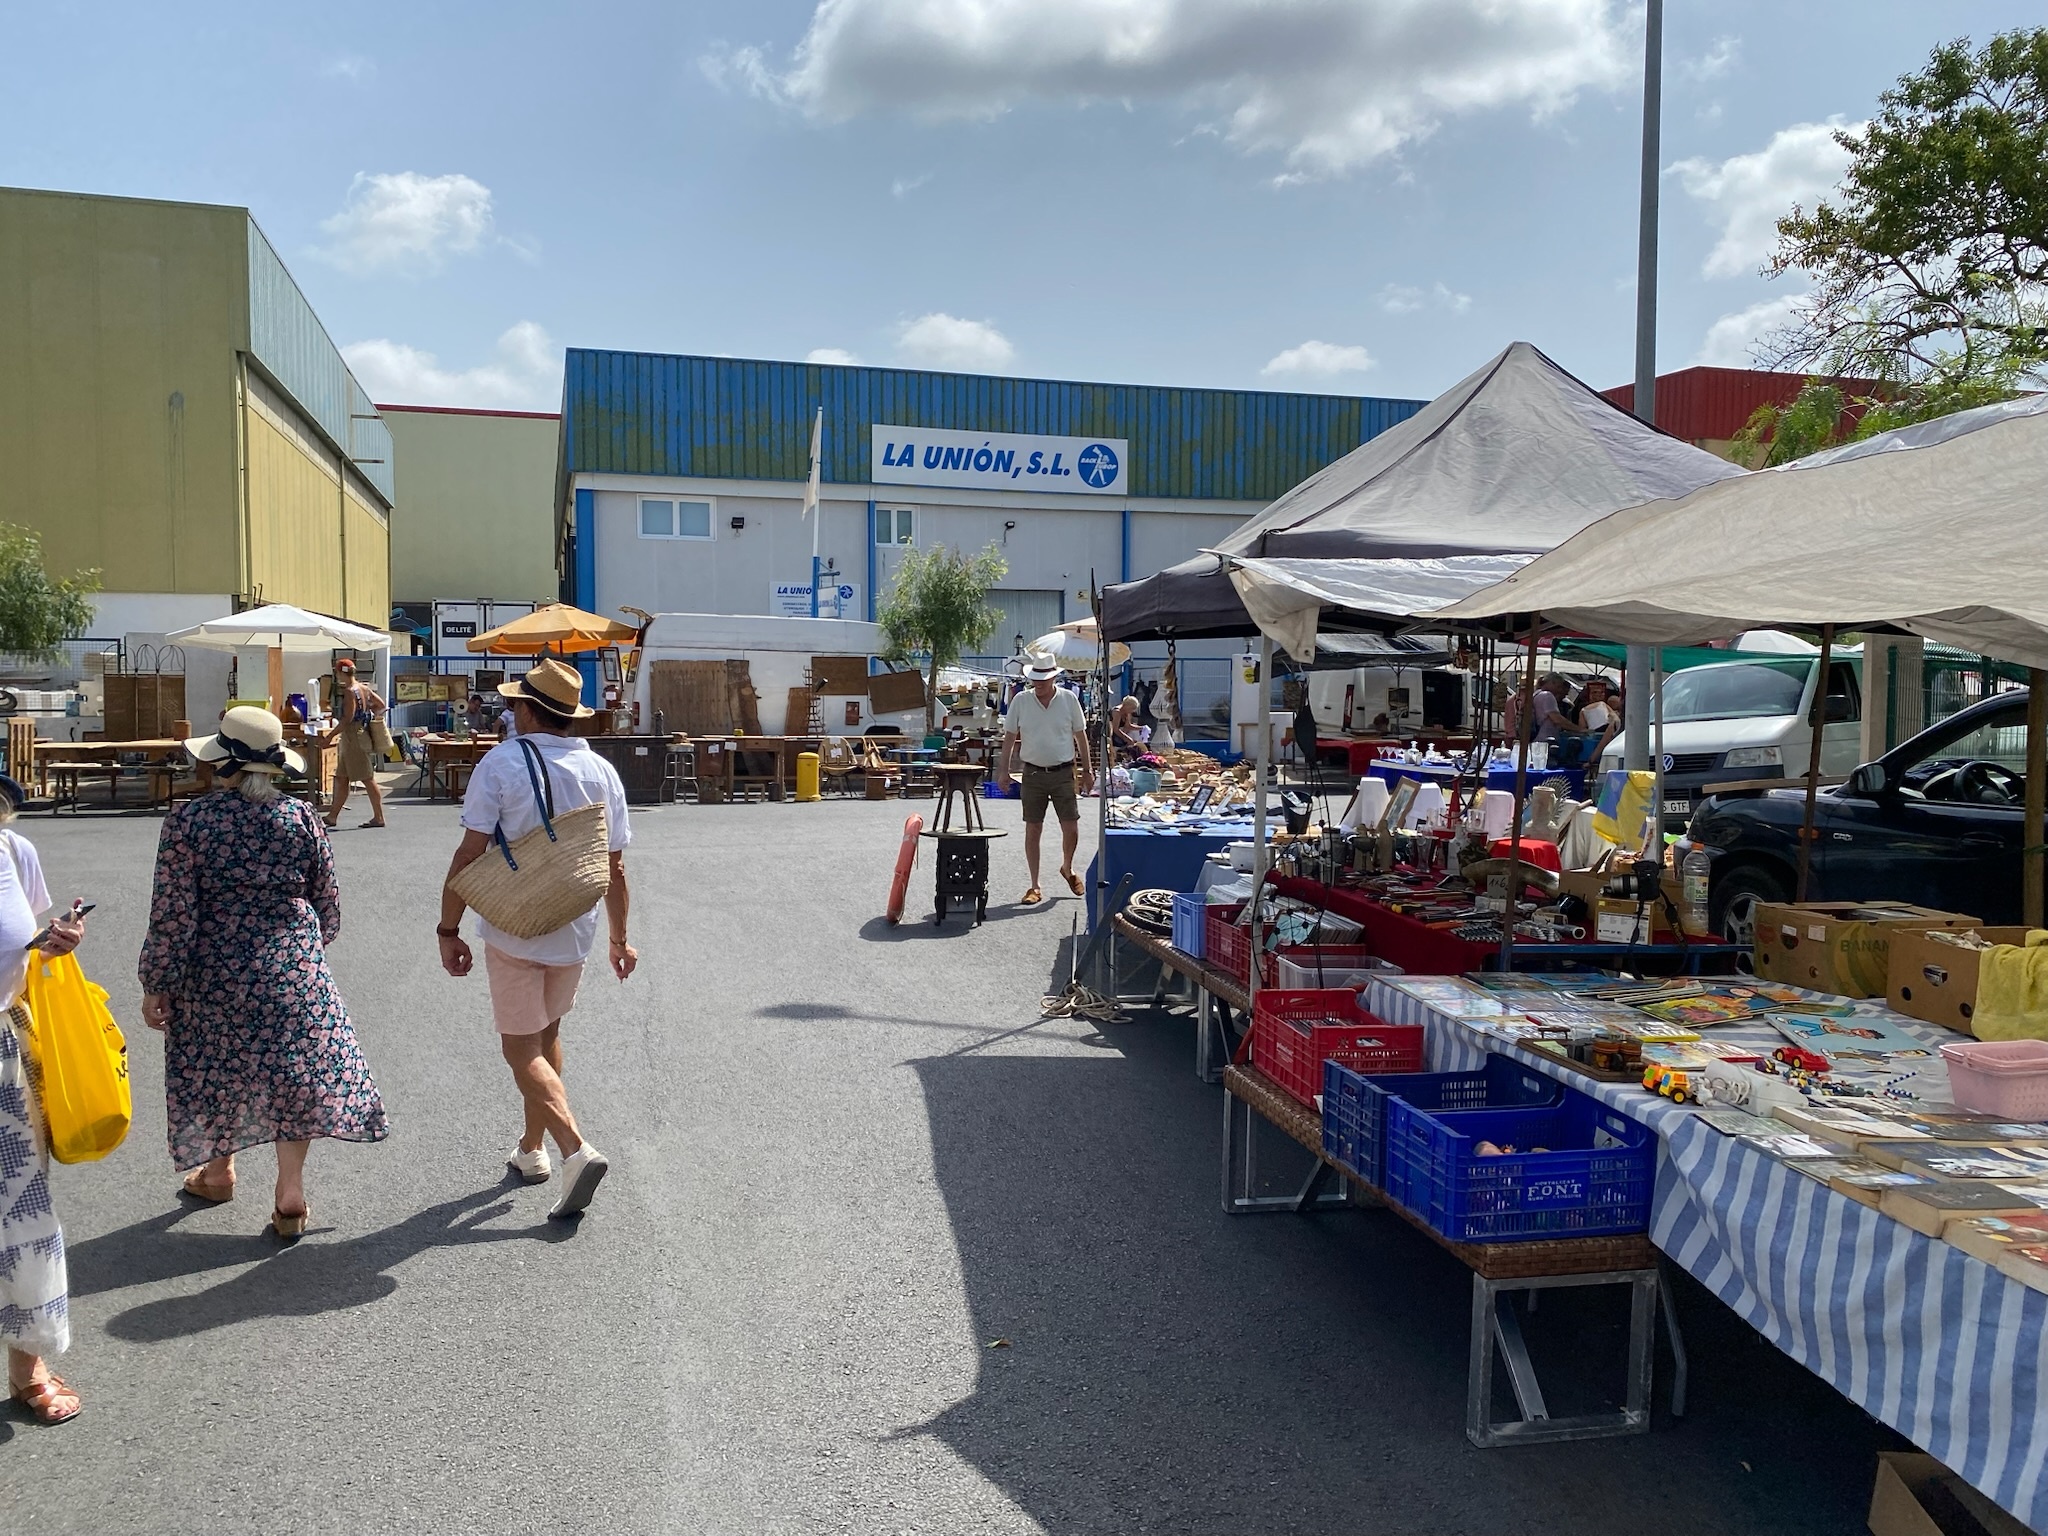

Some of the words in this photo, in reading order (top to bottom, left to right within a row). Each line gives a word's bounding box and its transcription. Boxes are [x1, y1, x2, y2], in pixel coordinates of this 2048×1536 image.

[882, 443, 914, 467] LA
[923, 442, 1022, 478] UNIÓN,
[1026, 451, 1071, 476] S.L.
[777, 586, 788, 594] LA
[1528, 1183, 1582, 1197] FONT
